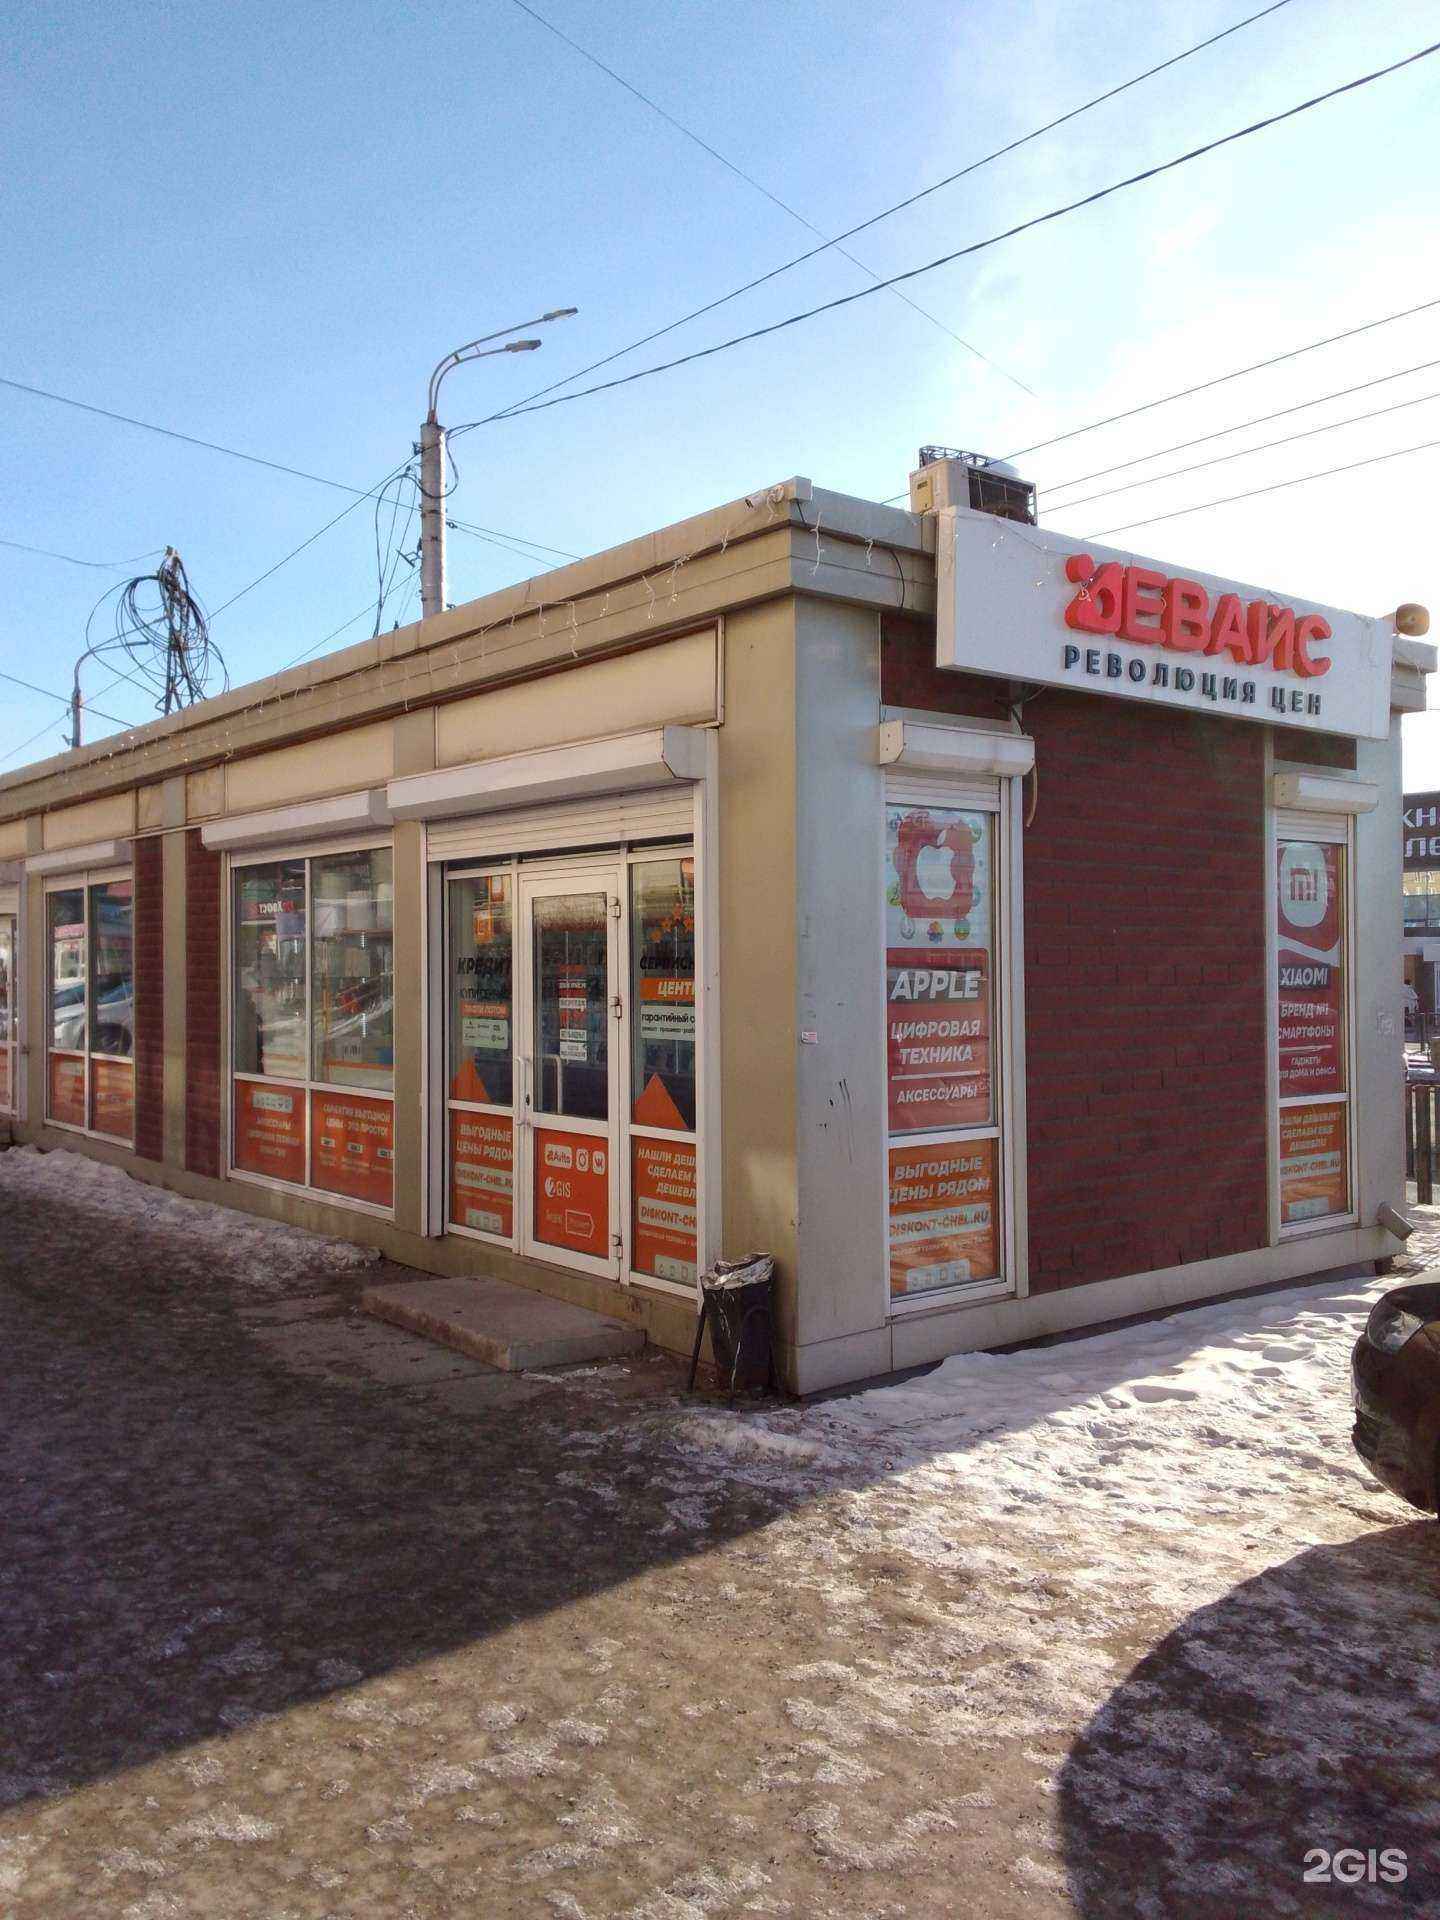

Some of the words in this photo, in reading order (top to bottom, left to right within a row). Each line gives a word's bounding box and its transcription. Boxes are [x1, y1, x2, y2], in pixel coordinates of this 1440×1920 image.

[1063, 644, 1256, 704] РЕВОЛЮЦИЯ
[1271, 686, 1322, 715] ЦЕН
[889, 969, 981, 1000] APPLE
[1279, 967, 1329, 987] XIAOMI
[641, 1012, 688, 1023] гарантийный
[1280, 1003, 1314, 1018] БРЕНД
[890, 1019, 981, 1043] ЦИФРОВАЯ
[900, 1045, 973, 1065] ТЕХНИКА
[896, 1085, 978, 1104] АКСЕССУАРЫ
[460, 1123, 512, 1142] ВЫГОДНЫЕ
[638, 1147, 672, 1162] НАШЛИ
[647, 1164, 691, 1183] СДЕЛАЕМ
[894, 1156, 984, 1181] ВЫГОДНЫЕ
[937, 1177, 991, 1198] РЯДОМ
